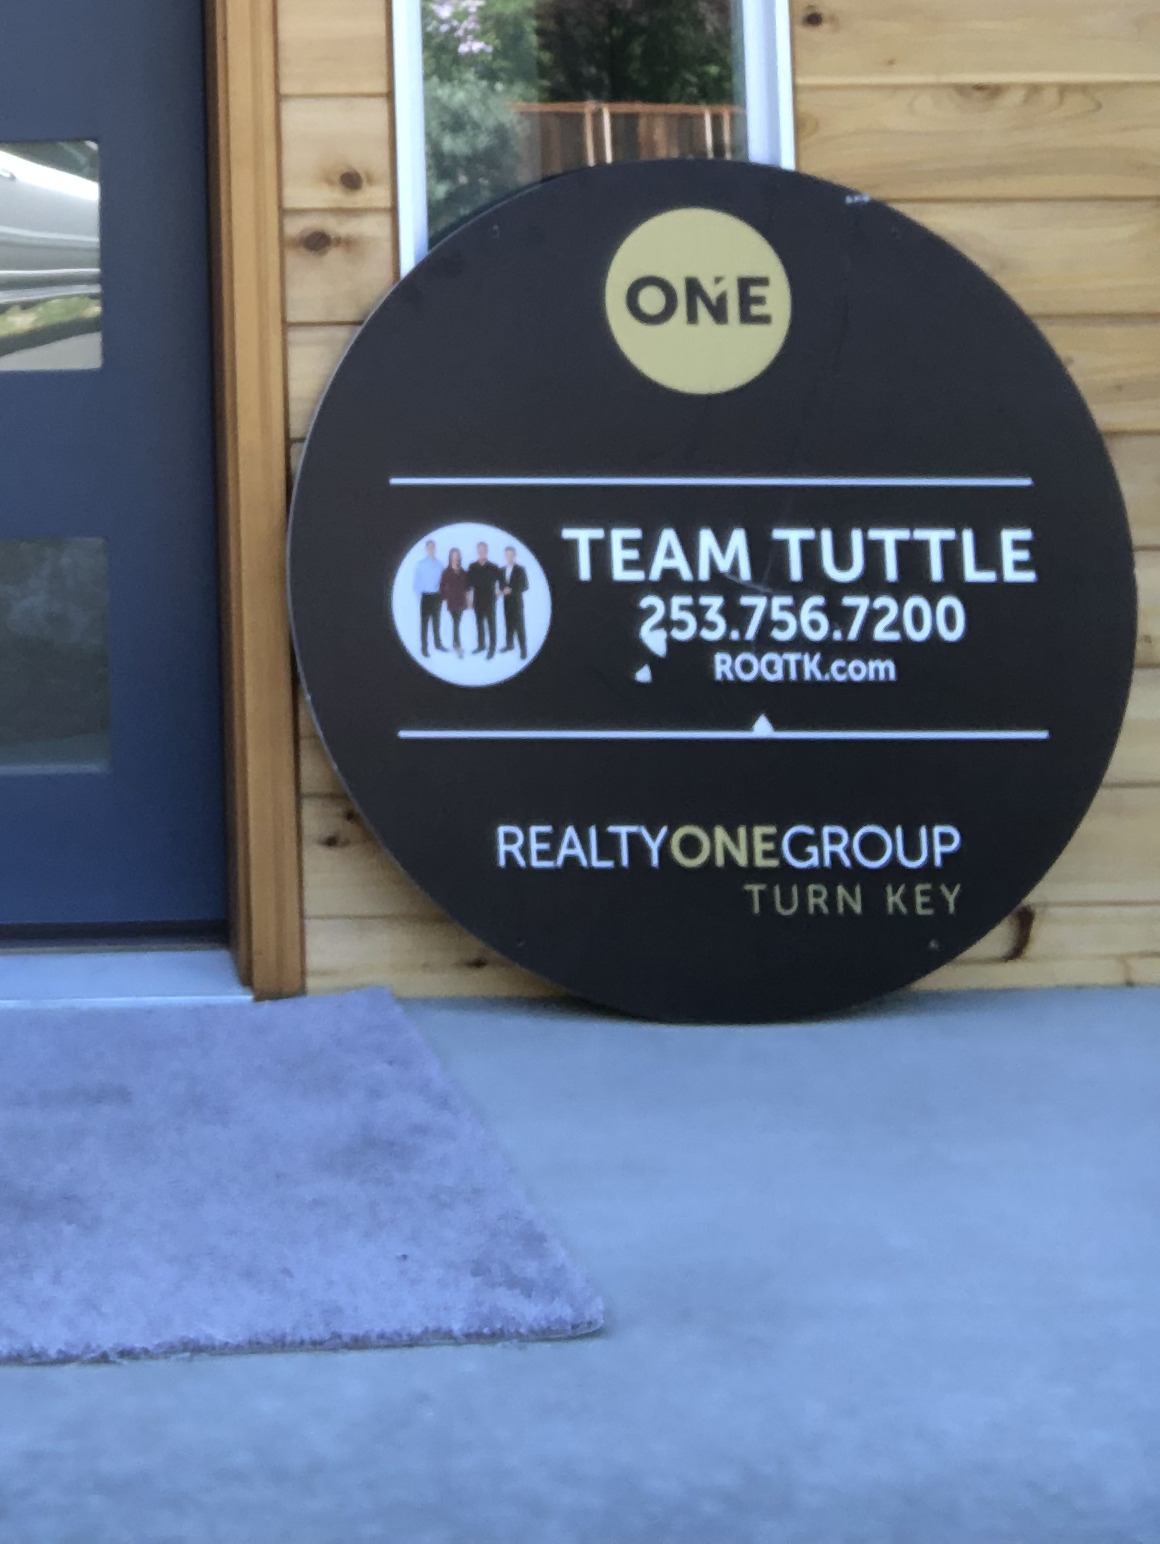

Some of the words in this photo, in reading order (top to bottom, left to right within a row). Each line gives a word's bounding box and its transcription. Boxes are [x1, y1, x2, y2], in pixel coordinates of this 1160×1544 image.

[624, 274, 773, 327] ONE
[560, 527, 753, 583] TEAM
[771, 527, 1038, 584] TUTTLE
[638, 594, 967, 644] 253.756.7200
[744, 882, 863, 916] TURN
[885, 882, 962, 916] KEY
